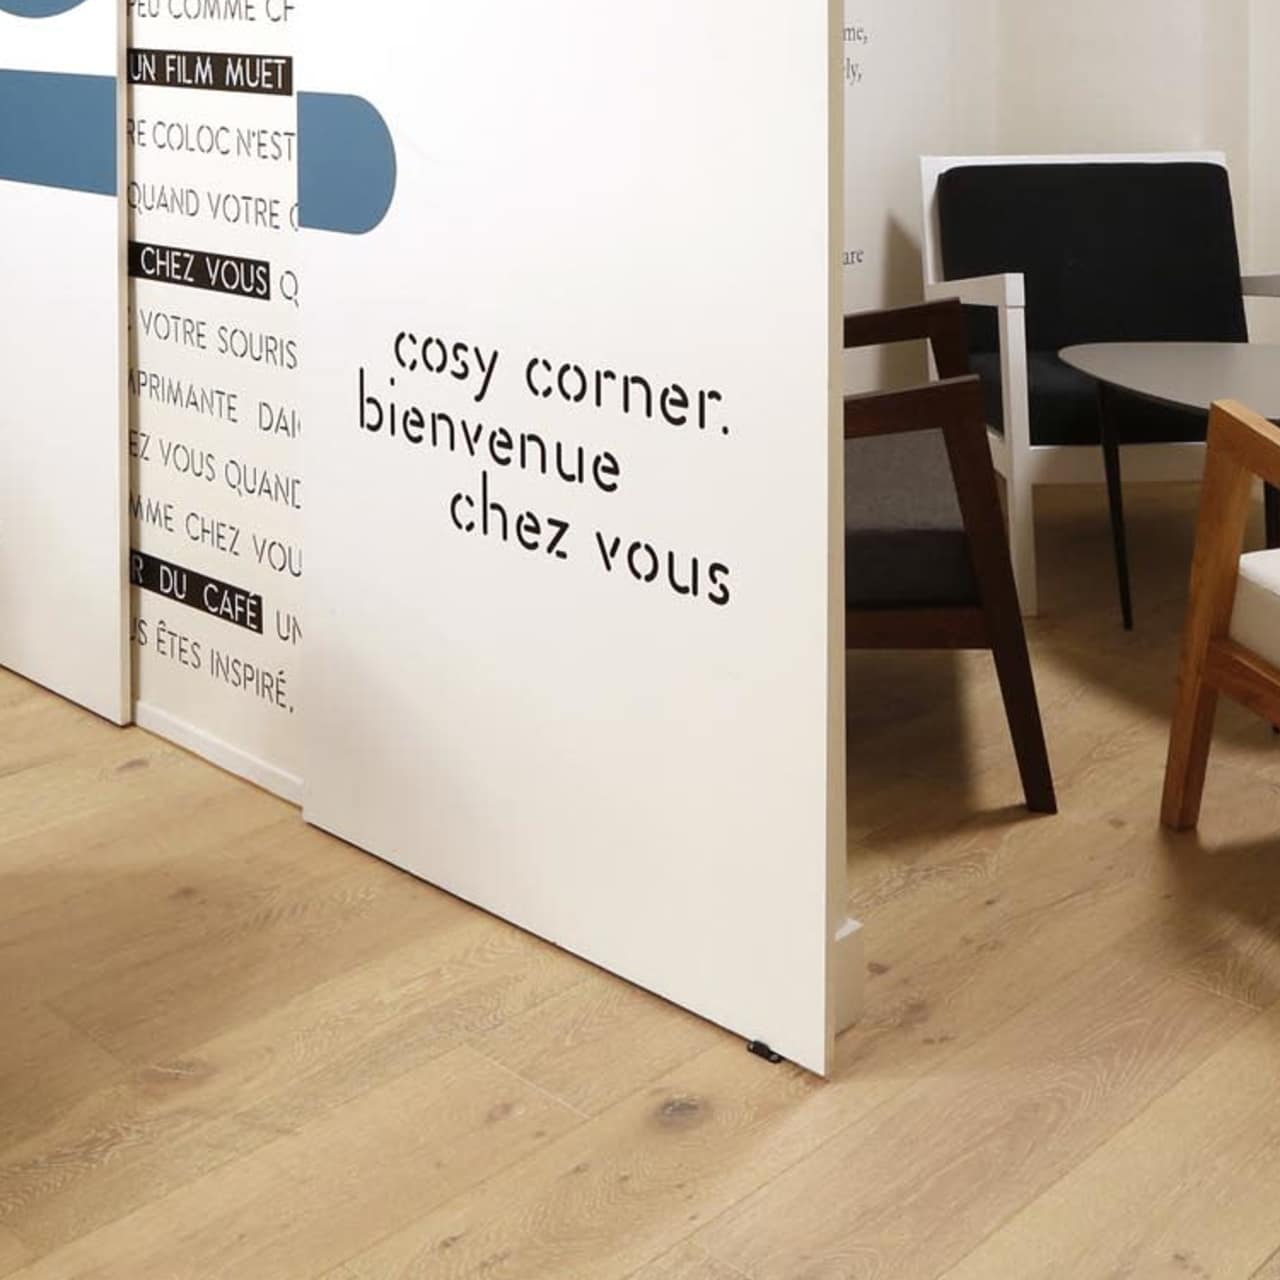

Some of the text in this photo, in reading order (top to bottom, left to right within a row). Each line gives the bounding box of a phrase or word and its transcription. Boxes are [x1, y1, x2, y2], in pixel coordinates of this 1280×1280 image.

[130, 53, 288, 89] UN FILM MUET
[152, 120, 230, 155] COLOC
[236, 128, 297, 161] N'EST
[128, 181, 200, 217] QUAND
[207, 191, 282, 230] VOTRE
[140, 246, 300, 308] CHEZ VOUS Q
[140, 308, 298, 369] VOTRE SOURIS
[394, 331, 730, 436] cosy corner.
[159, 439, 216, 483] VOUS
[359, 366, 621, 493] bienvenue
[185, 512, 240, 556] CHEZ
[252, 535, 302, 577] VOU
[449, 469, 731, 607] chez vous
[159, 565, 187, 600] DU
[203, 583, 259, 630] CAFÉ
[156, 619, 202, 670] ÊTES
[210, 647, 295, 713] INSPIRÉ,
